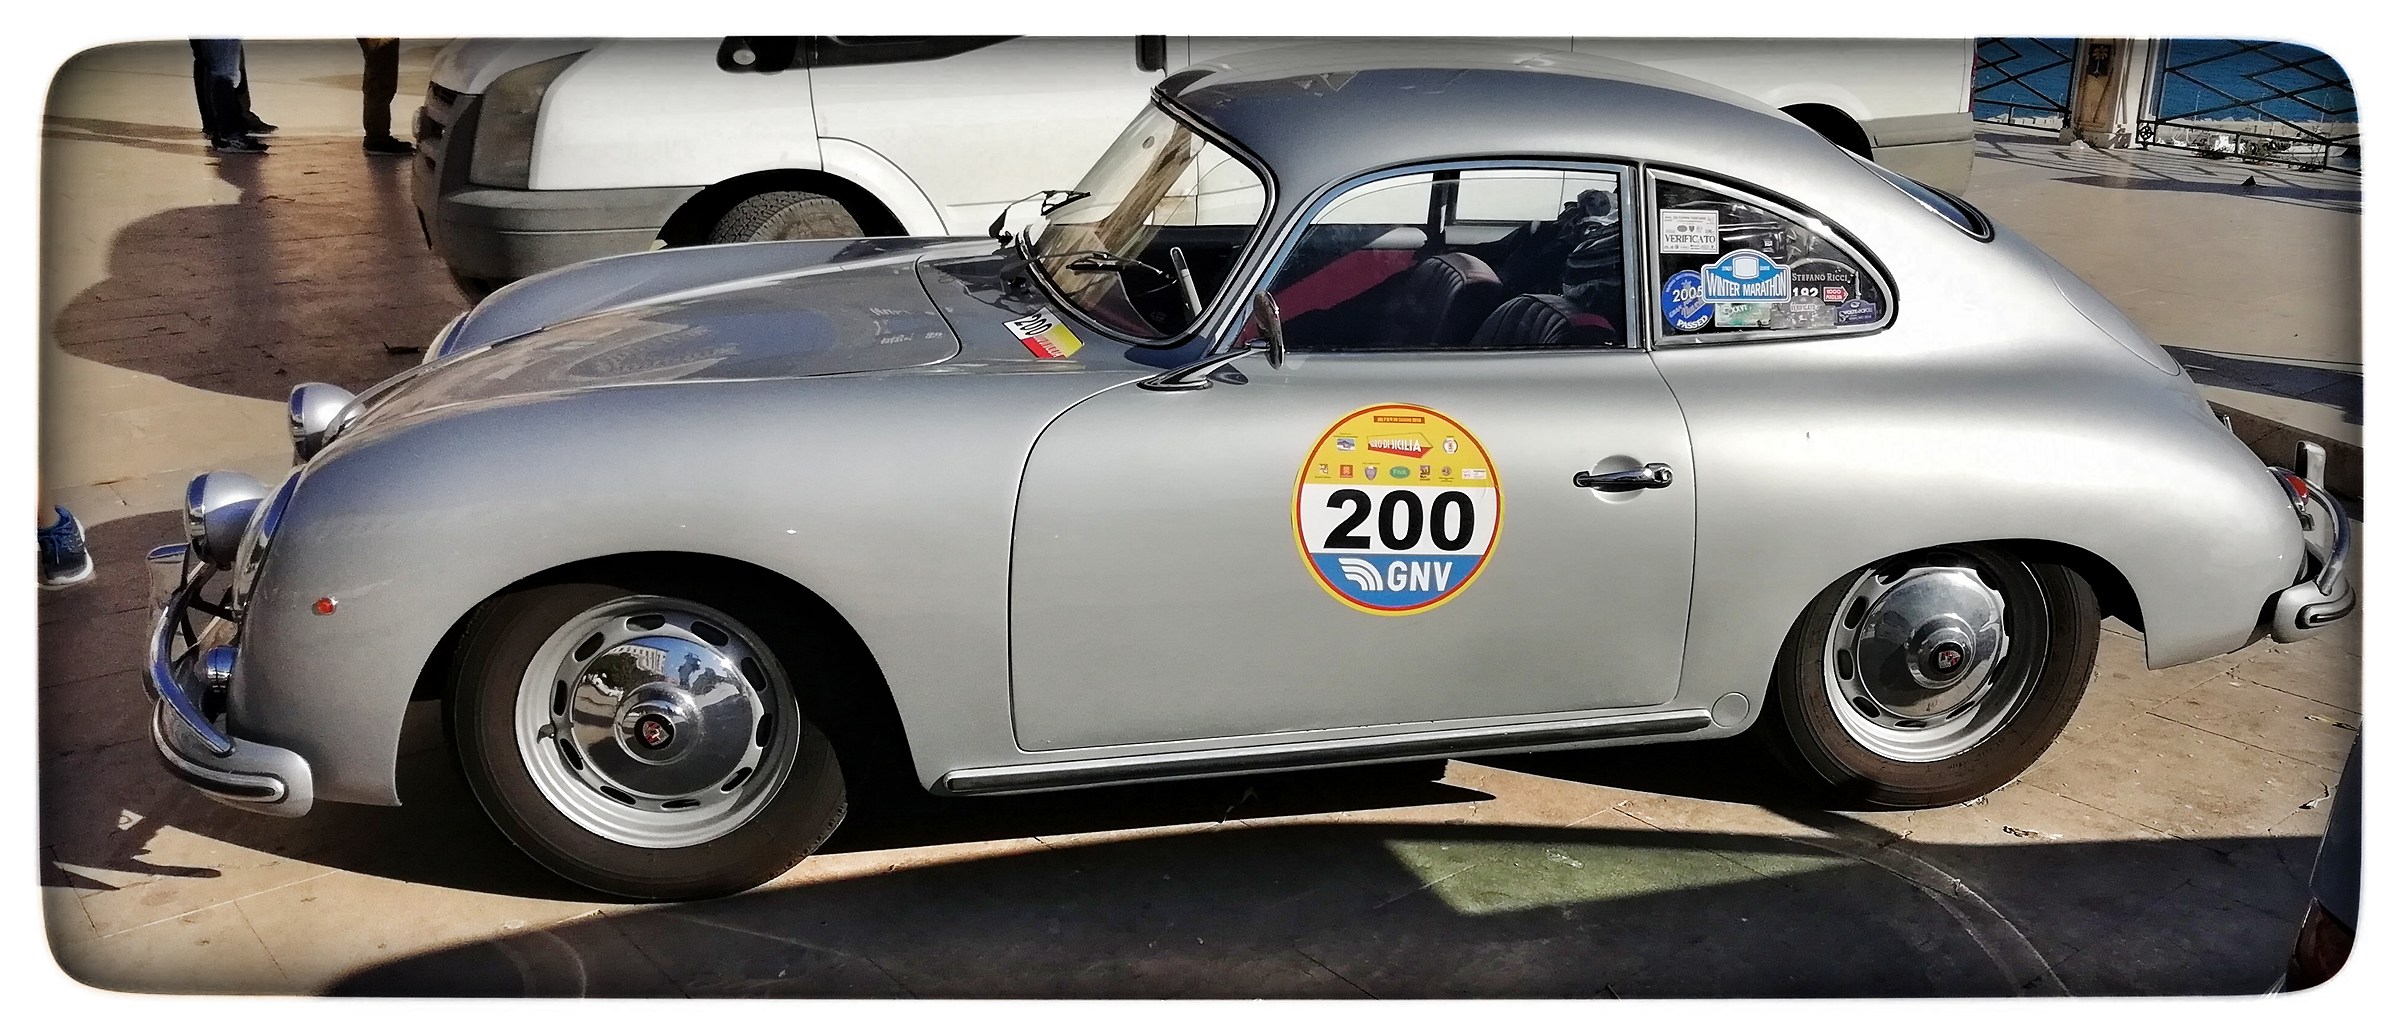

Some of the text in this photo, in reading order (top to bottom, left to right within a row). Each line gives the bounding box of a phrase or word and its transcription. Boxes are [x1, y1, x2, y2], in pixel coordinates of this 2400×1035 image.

[1665, 234, 1716, 243] VERIFICATO
[1705, 269, 1740, 297] WINTER
[1743, 269, 1787, 297] MARATHON
[1792, 272, 1848, 281] STEFANO RICCI
[1013, 313, 1053, 336] 200
[1676, 315, 1708, 329] PASSED
[1391, 439, 1422, 453] SICILIA
[1323, 488, 1475, 551] 200
[1387, 561, 1453, 592] GNV
